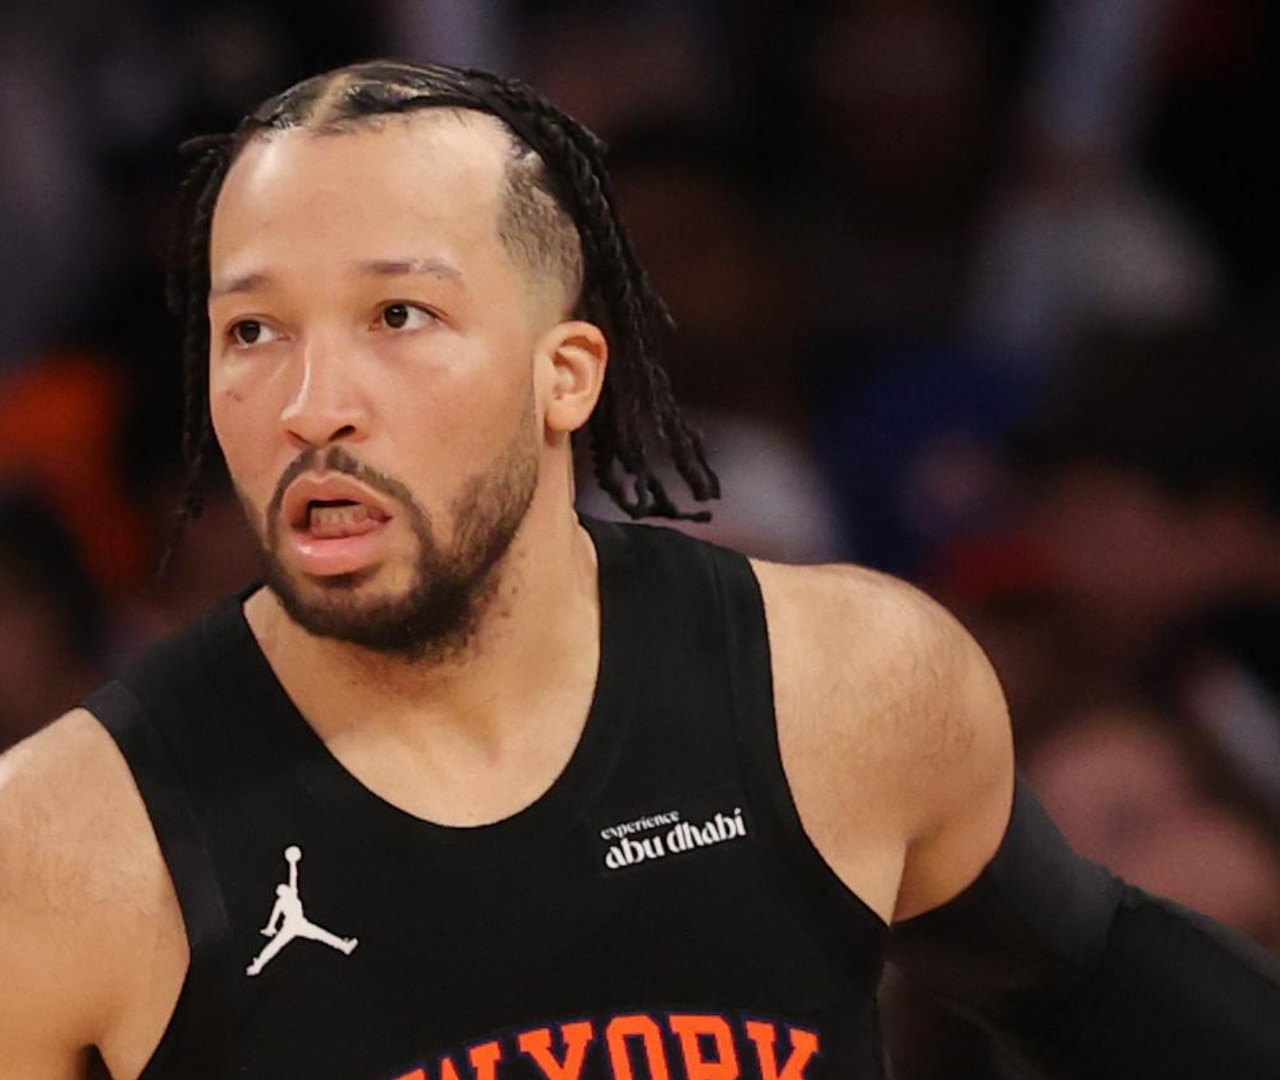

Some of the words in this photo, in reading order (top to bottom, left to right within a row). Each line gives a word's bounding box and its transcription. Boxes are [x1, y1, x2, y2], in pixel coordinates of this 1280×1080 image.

[599, 810, 680, 840] experience
[604, 837, 665, 869] abu
[666, 807, 747, 853] dhabi
